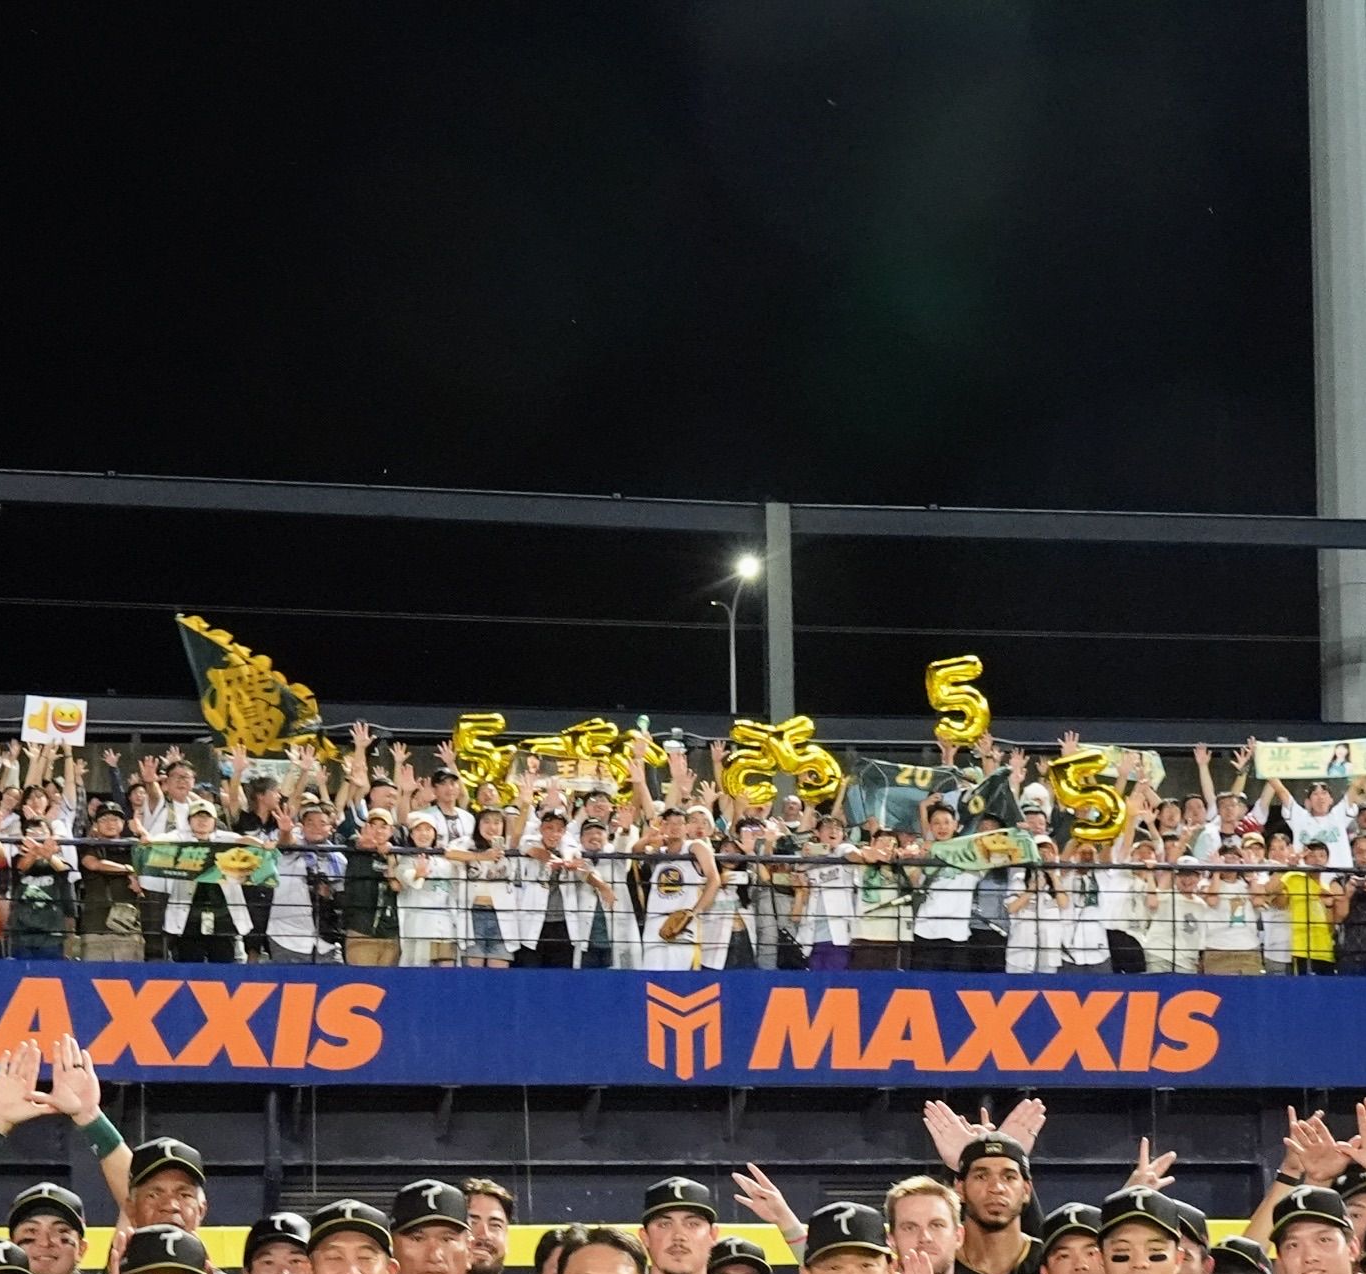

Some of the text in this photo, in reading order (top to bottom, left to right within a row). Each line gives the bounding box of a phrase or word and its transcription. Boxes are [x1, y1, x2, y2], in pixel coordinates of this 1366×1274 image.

[926, 655, 991, 746] 5
[1048, 749, 1127, 842] 5
[750, 989, 1221, 1073] MAXXIS
